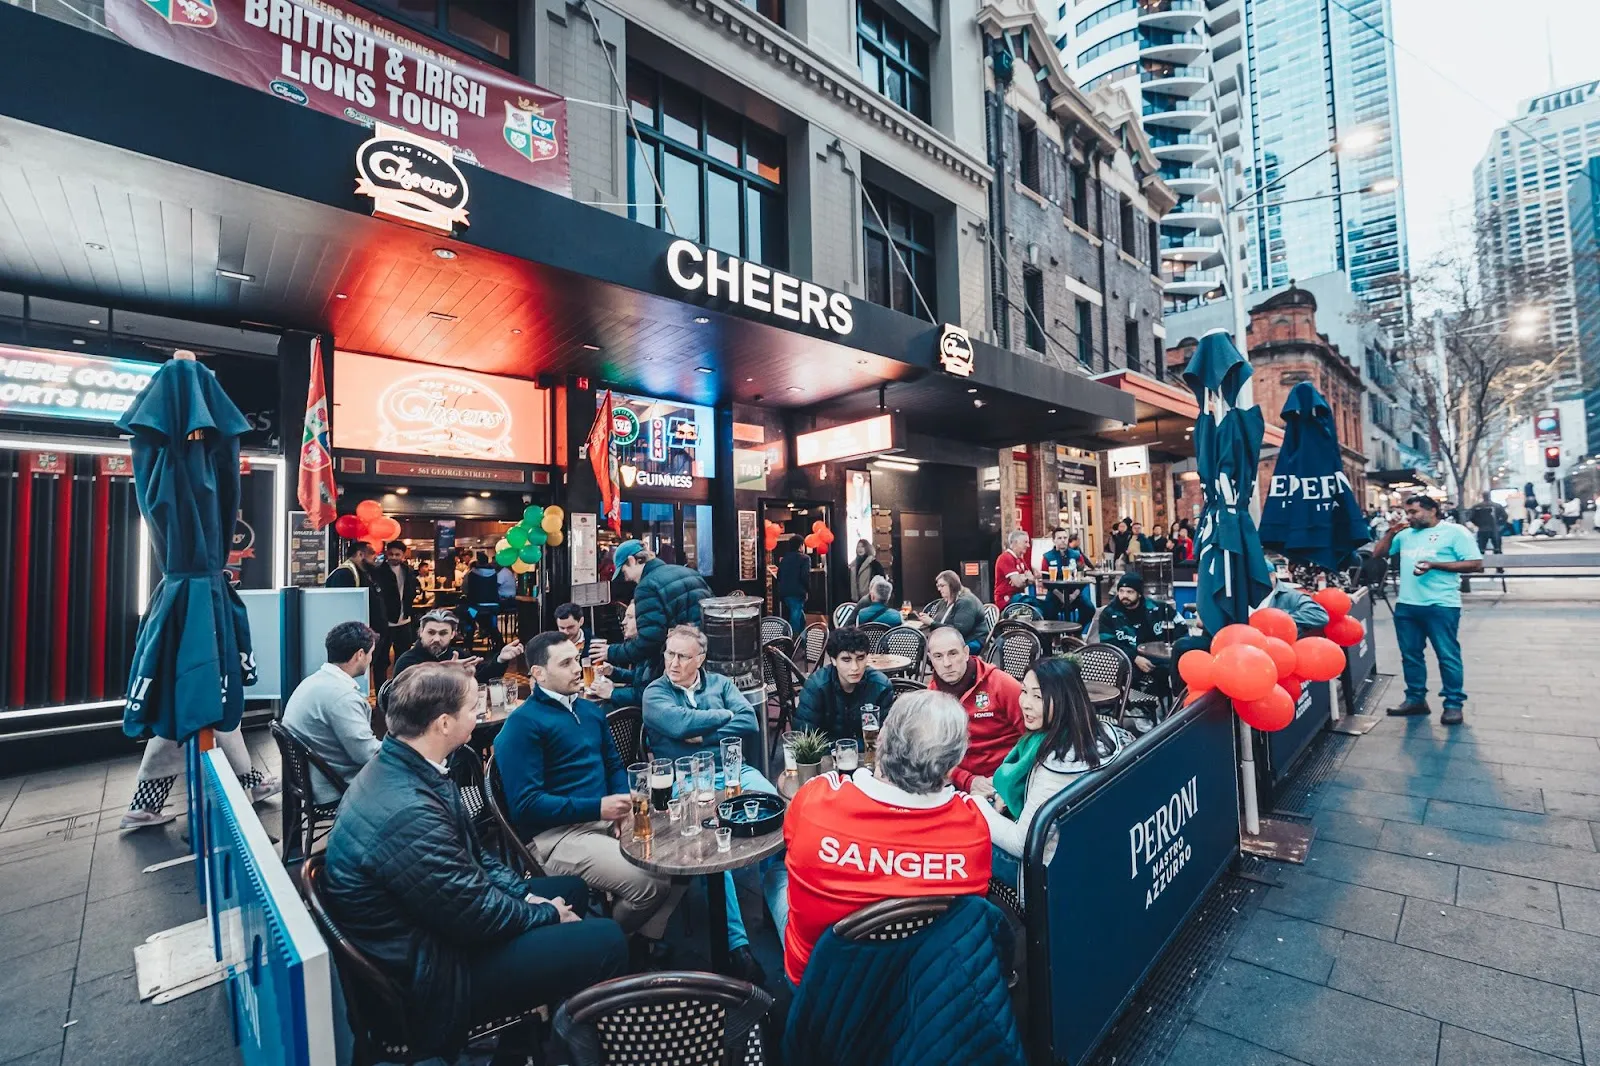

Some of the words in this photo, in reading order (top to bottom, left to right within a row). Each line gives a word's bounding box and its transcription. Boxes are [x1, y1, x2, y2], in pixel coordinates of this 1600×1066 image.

[298, 0, 343, 20] HEERS
[346, 13, 371, 33] BAR
[373, 23, 435, 60] WELCOMES
[437, 52, 457, 66] THE
[245, 0, 375, 71] BRITISH
[384, 47, 406, 84] &
[416, 59, 487, 118] IRISH
[281, 43, 376, 108] LIONS
[385, 84, 459, 139] TOUR
[369, 151, 458, 199] Cheers
[666, 239, 854, 336] CHEERS
[391, 388, 504, 428] Cheers
[653, 419, 663, 458] OPEN
[417, 467, 429, 475] 561
[431, 468, 463, 477] GEORGE
[464, 470, 492, 479] STREET
[636, 470, 693, 489] GUINNESS
[740, 463, 761, 476] TAB
[1129, 775, 1199, 879] PERONI
[818, 836, 968, 880] SANGER
[1145, 844, 1192, 910] AZZURRO
[1152, 835, 1184, 879] NASTRO
